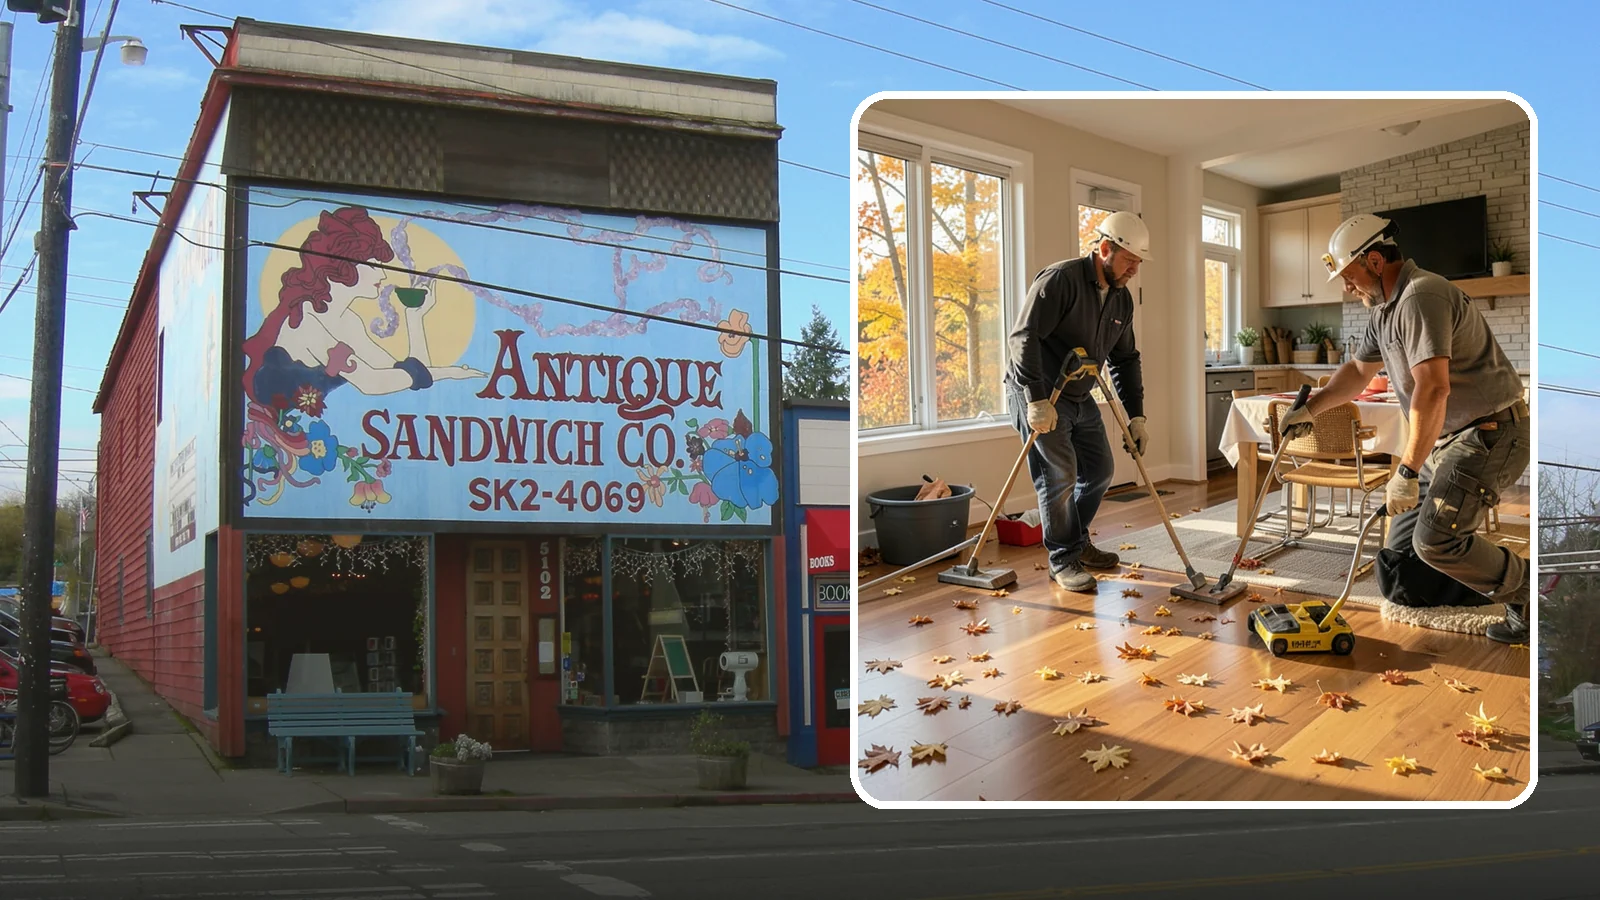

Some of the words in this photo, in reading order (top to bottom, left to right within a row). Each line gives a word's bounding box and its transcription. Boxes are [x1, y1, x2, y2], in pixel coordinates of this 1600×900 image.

[475, 329, 723, 420] ANTIQUE
[361, 408, 604, 467] SANDWICH
[617, 422, 685, 469] CO.
[469, 477, 646, 512] SK2-4069
[540, 541, 551, 600] 5102
[809, 555, 835, 569] BOOKS
